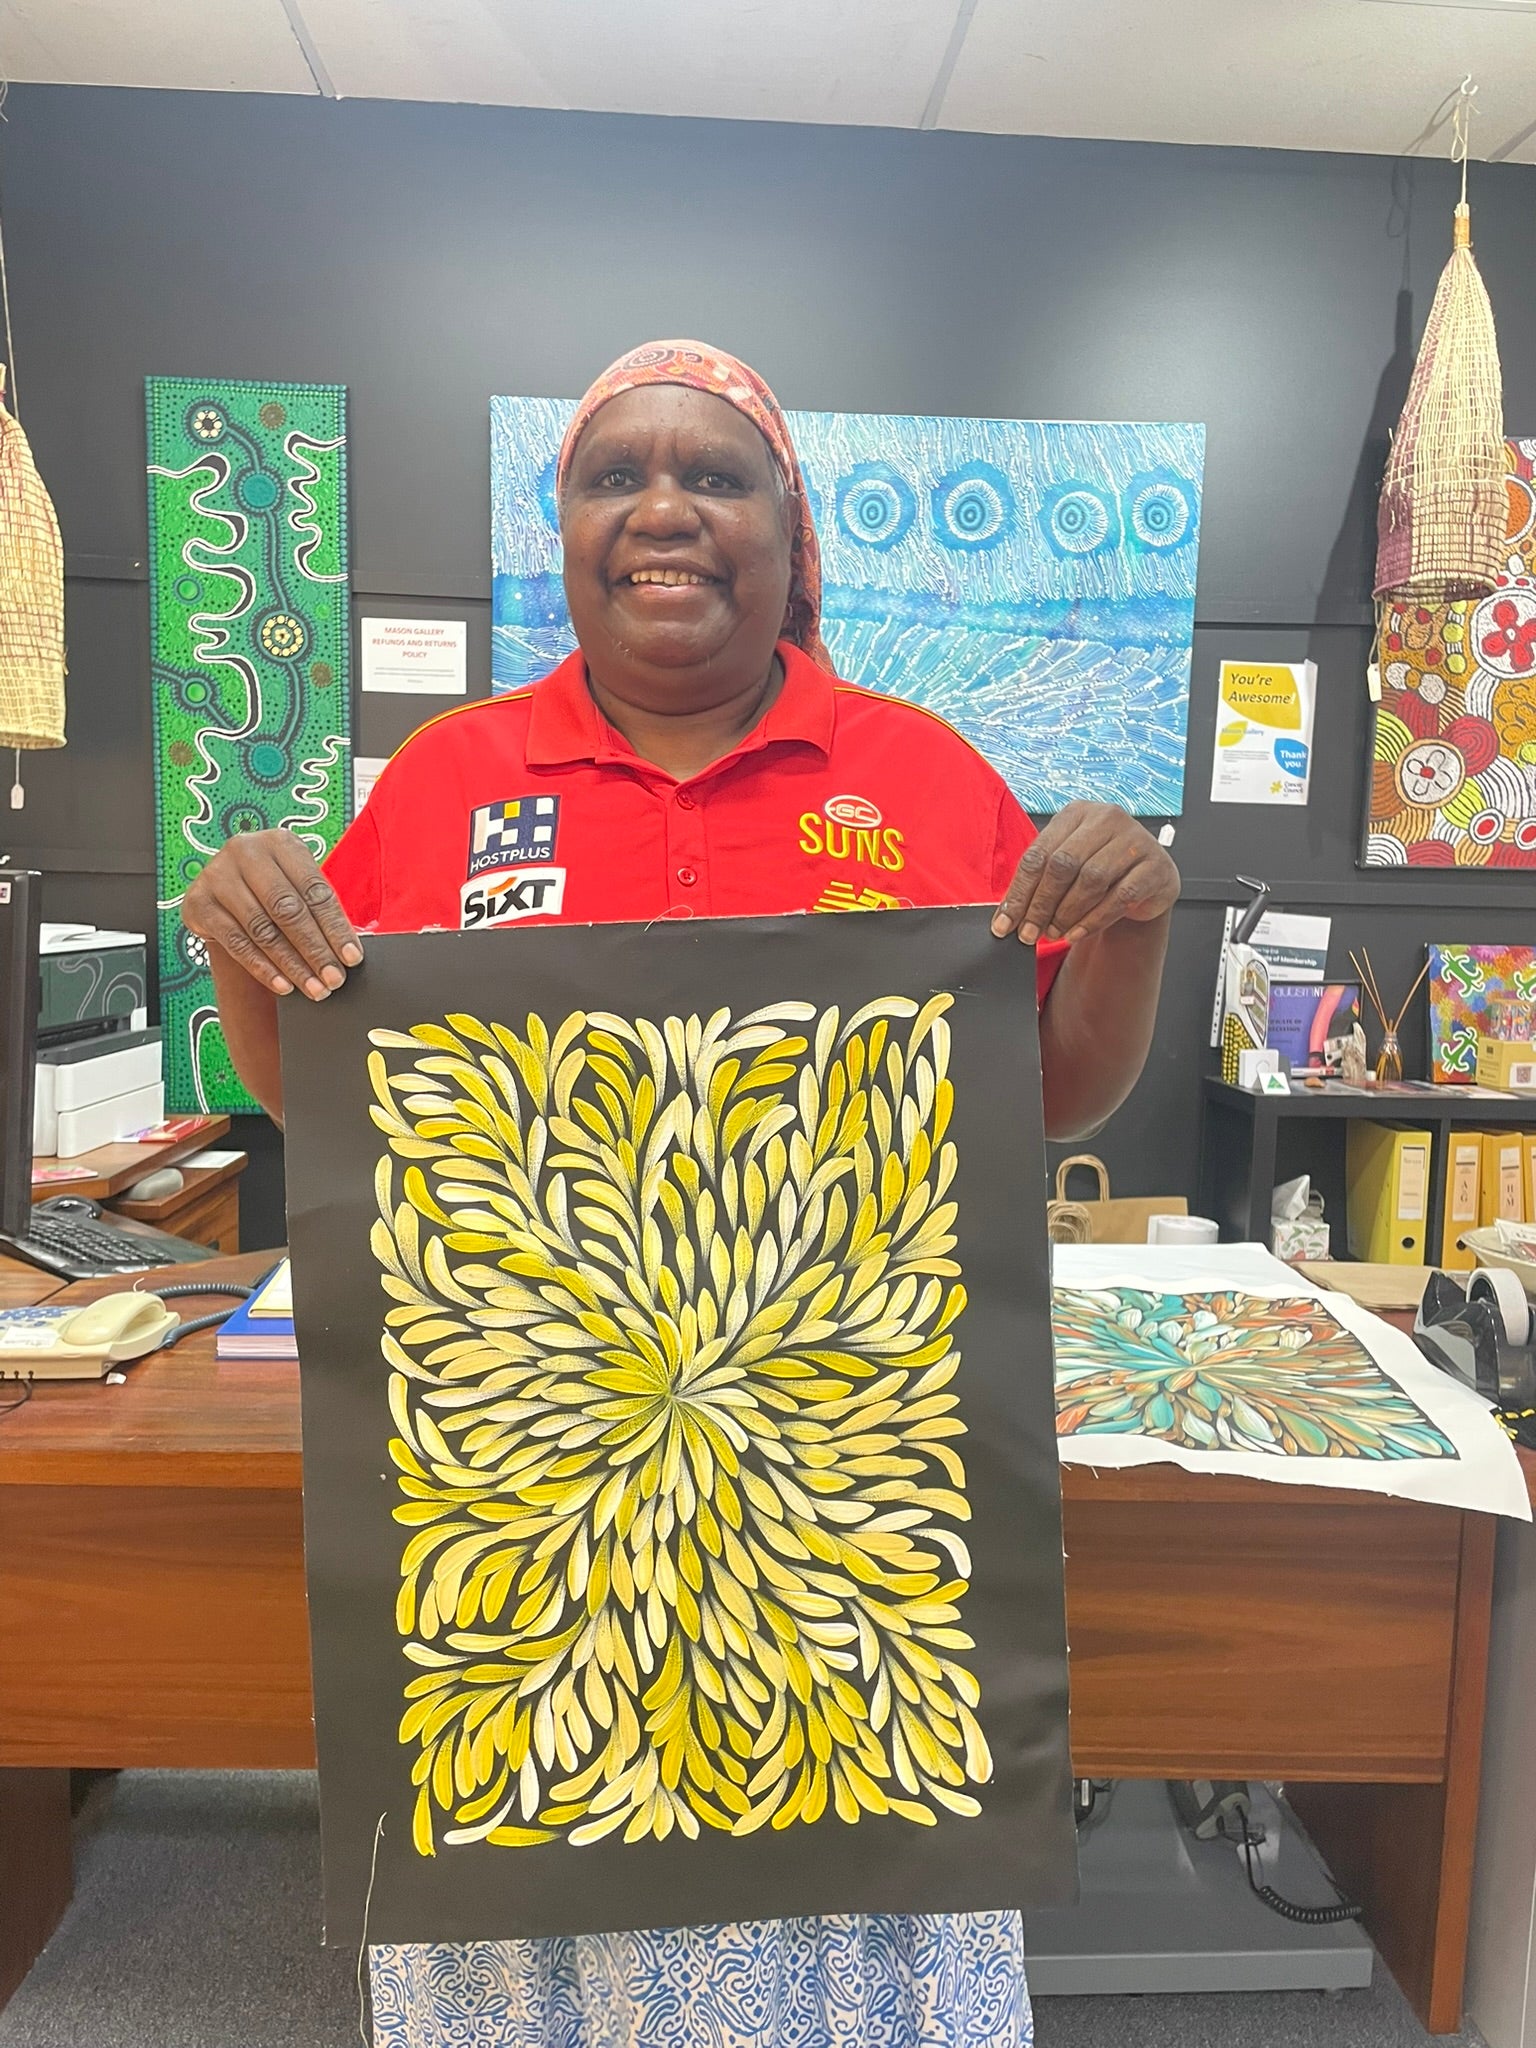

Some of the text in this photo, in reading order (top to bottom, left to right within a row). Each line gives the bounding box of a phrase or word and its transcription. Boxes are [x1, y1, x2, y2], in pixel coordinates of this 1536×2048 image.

[384, 627, 412, 635] MASON
[372, 638, 457, 648] REFUNDS AND RETURNS
[1230, 673, 1273, 686] You're
[1228, 691, 1296, 705] Awesome!
[1280, 750, 1307, 759] Thank
[799, 812, 905, 872] SUNS
[470, 847, 551, 874] HOSTPLUS
